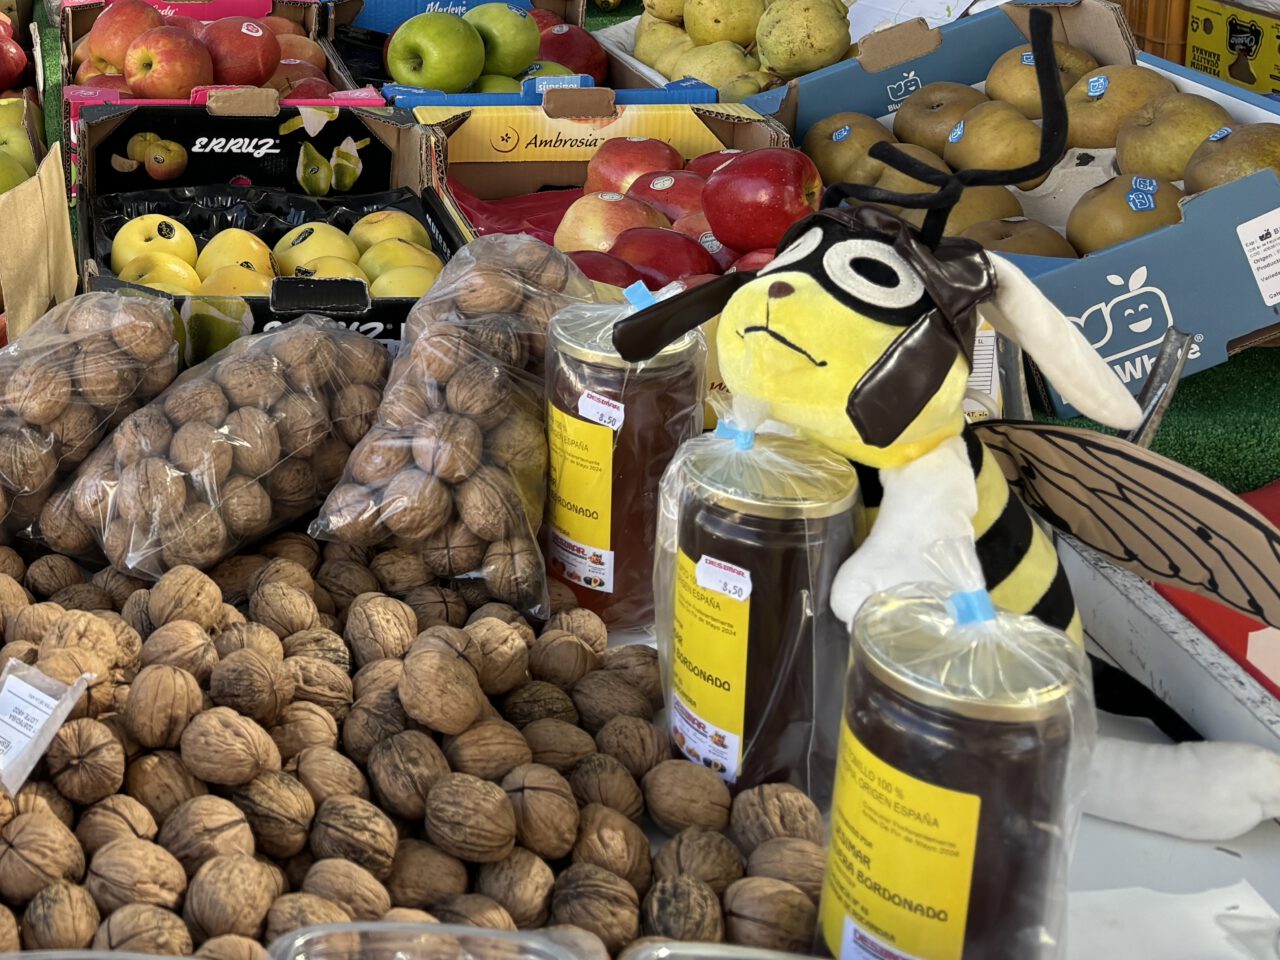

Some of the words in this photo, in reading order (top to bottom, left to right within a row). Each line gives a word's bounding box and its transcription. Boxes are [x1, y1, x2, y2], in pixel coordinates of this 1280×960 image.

[425, 1, 467, 17] Marlene
[887, 102, 903, 112] Blu
[191, 136, 281, 159] ERRUZ
[524, 131, 599, 150] Ambrosia
[1113, 343, 1202, 384] Whe
[692, 587, 721, 611] ESPAÑA
[722, 582, 744, 598] 8.50
[877, 777, 893, 793] 100
[858, 778, 892, 809] ORIGEN
[893, 801, 940, 829] ESPAÑA
[856, 870, 949, 922] BORDONADO
